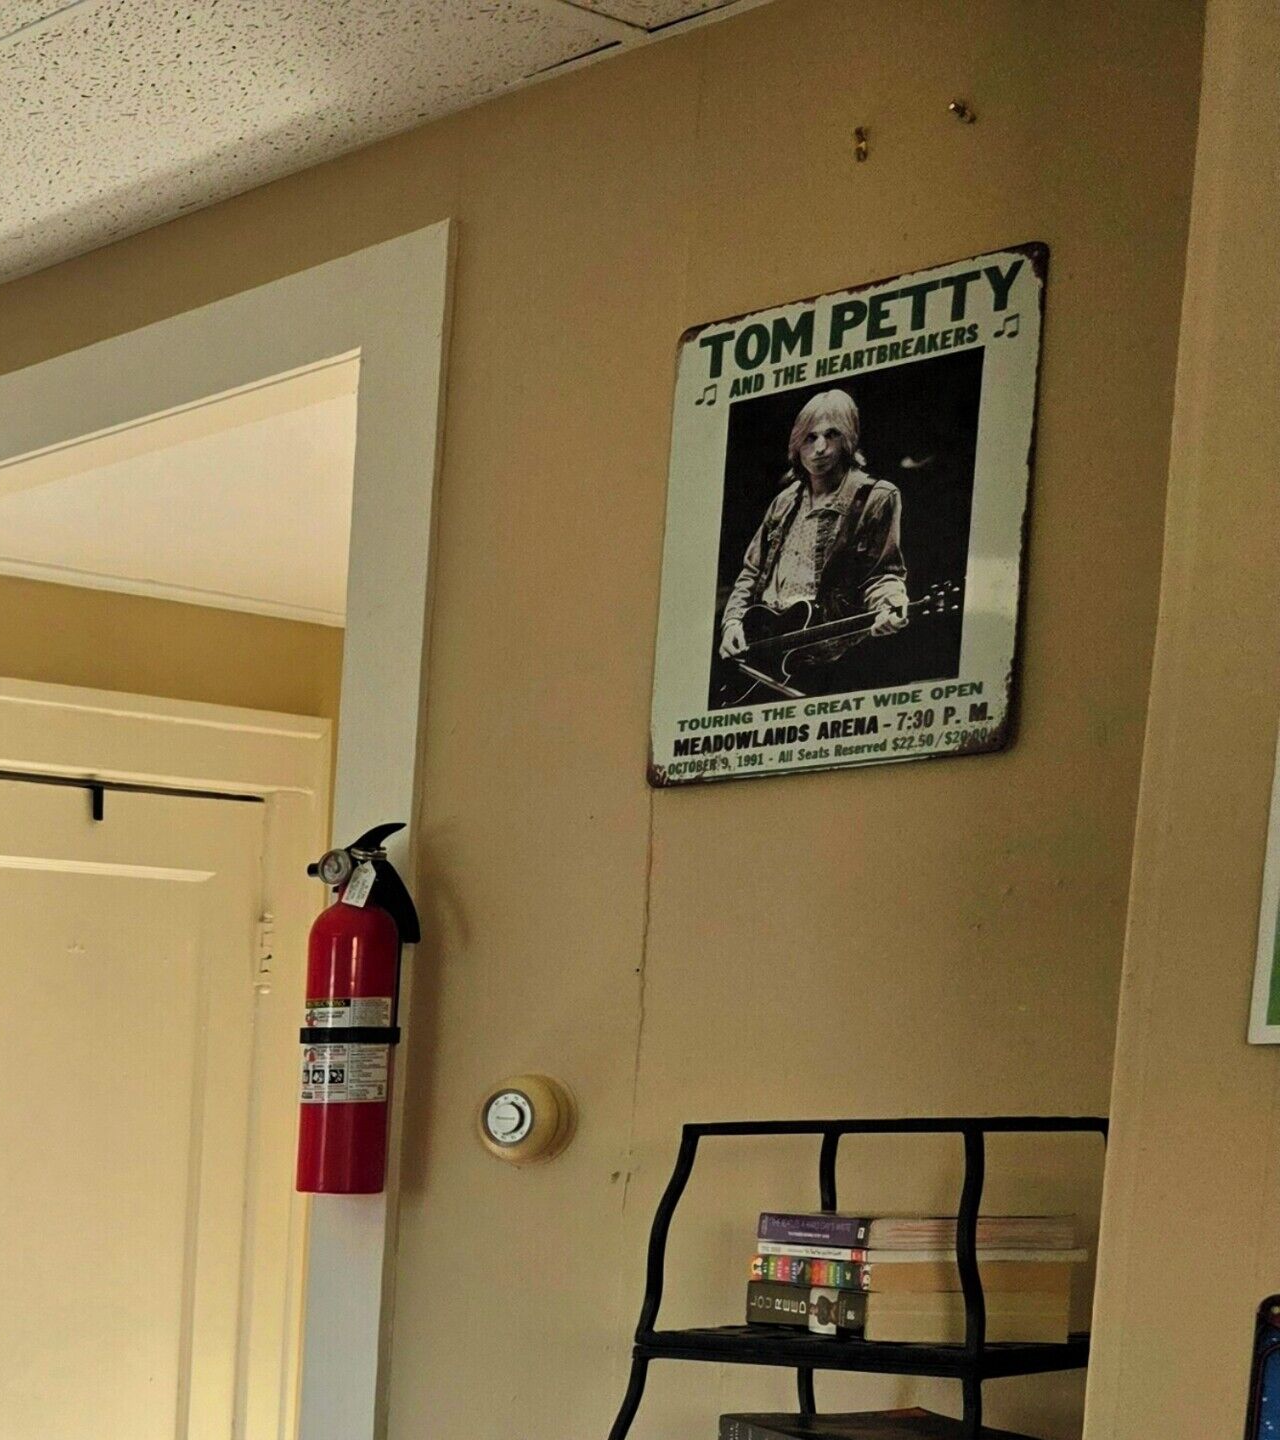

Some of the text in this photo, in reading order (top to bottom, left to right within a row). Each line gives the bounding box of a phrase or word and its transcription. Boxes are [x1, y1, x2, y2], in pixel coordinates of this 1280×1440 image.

[699, 259, 1025, 379] TOM PETTY
[729, 323, 979, 398] AND THE HEARTBREAKERS
[678, 681, 983, 732] TOURING THE GREAT WIDE OPEN
[668, 757, 718, 776] OCTOBER
[737, 753, 764, 768] 1991
[778, 750, 793, 763] All
[797, 746, 830, 761] Seats
[834, 739, 887, 757] Reserved
[673, 724, 810, 757] MEADOWLANDS
[816, 715, 878, 740] ARENA
[896, 708, 934, 731] 7:30
[775, 1298, 807, 1314] REED
